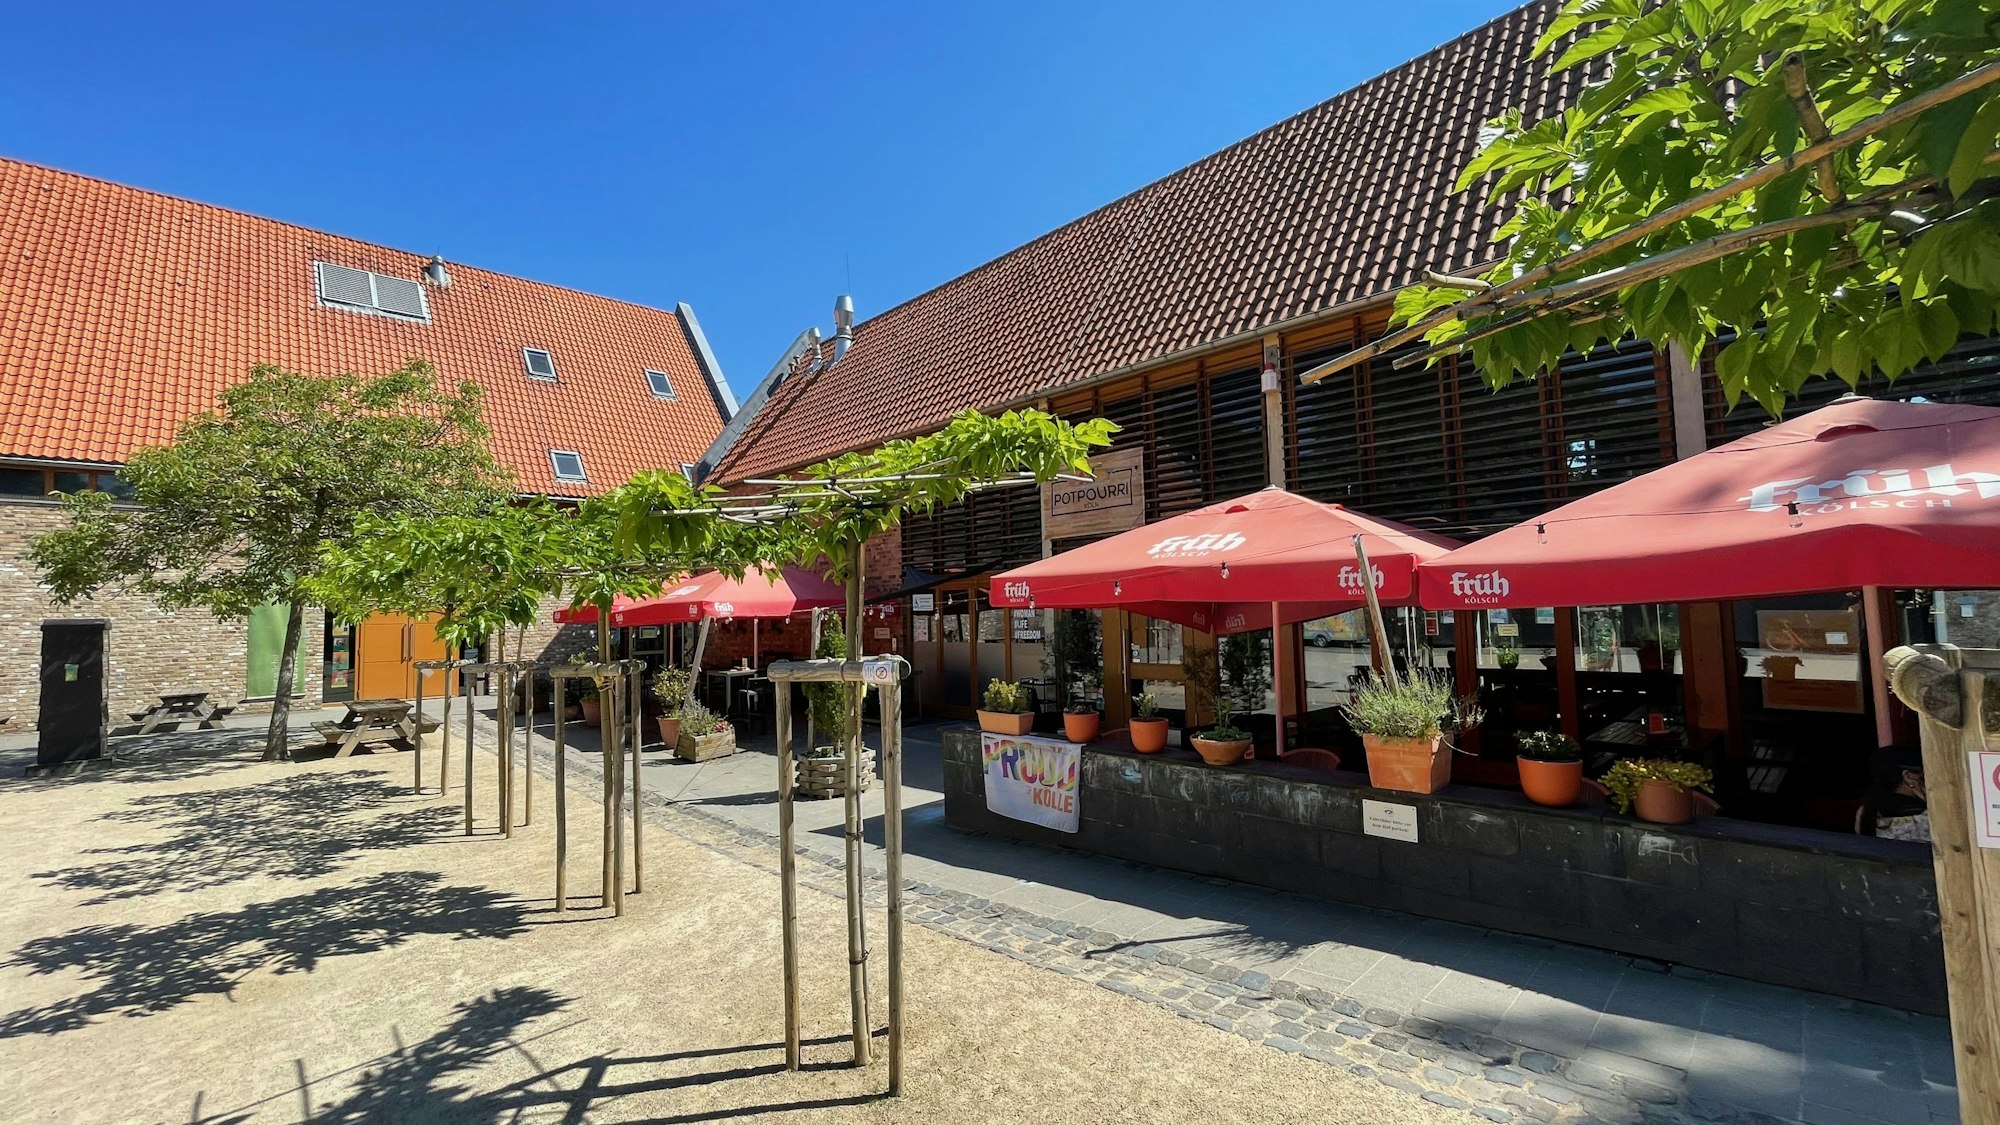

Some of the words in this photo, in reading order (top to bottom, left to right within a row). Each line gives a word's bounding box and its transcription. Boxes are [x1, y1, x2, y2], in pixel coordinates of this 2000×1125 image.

[1054, 482, 1129, 506] POTPOURRI
[1737, 463, 2000, 512] früh
[1797, 499, 1953, 516] KÖLSCH
[1146, 531, 1247, 555] früh
[1152, 551, 1210, 559] KÖLSCH
[1004, 581, 1030, 598] früh
[1450, 570, 1509, 597] früh
[714, 602, 733, 613] früh
[1014, 620, 1028, 628] #LIFE
[1014, 630, 1041, 639] #FREEDOM
[1032, 787, 1074, 813] KÖLLE
